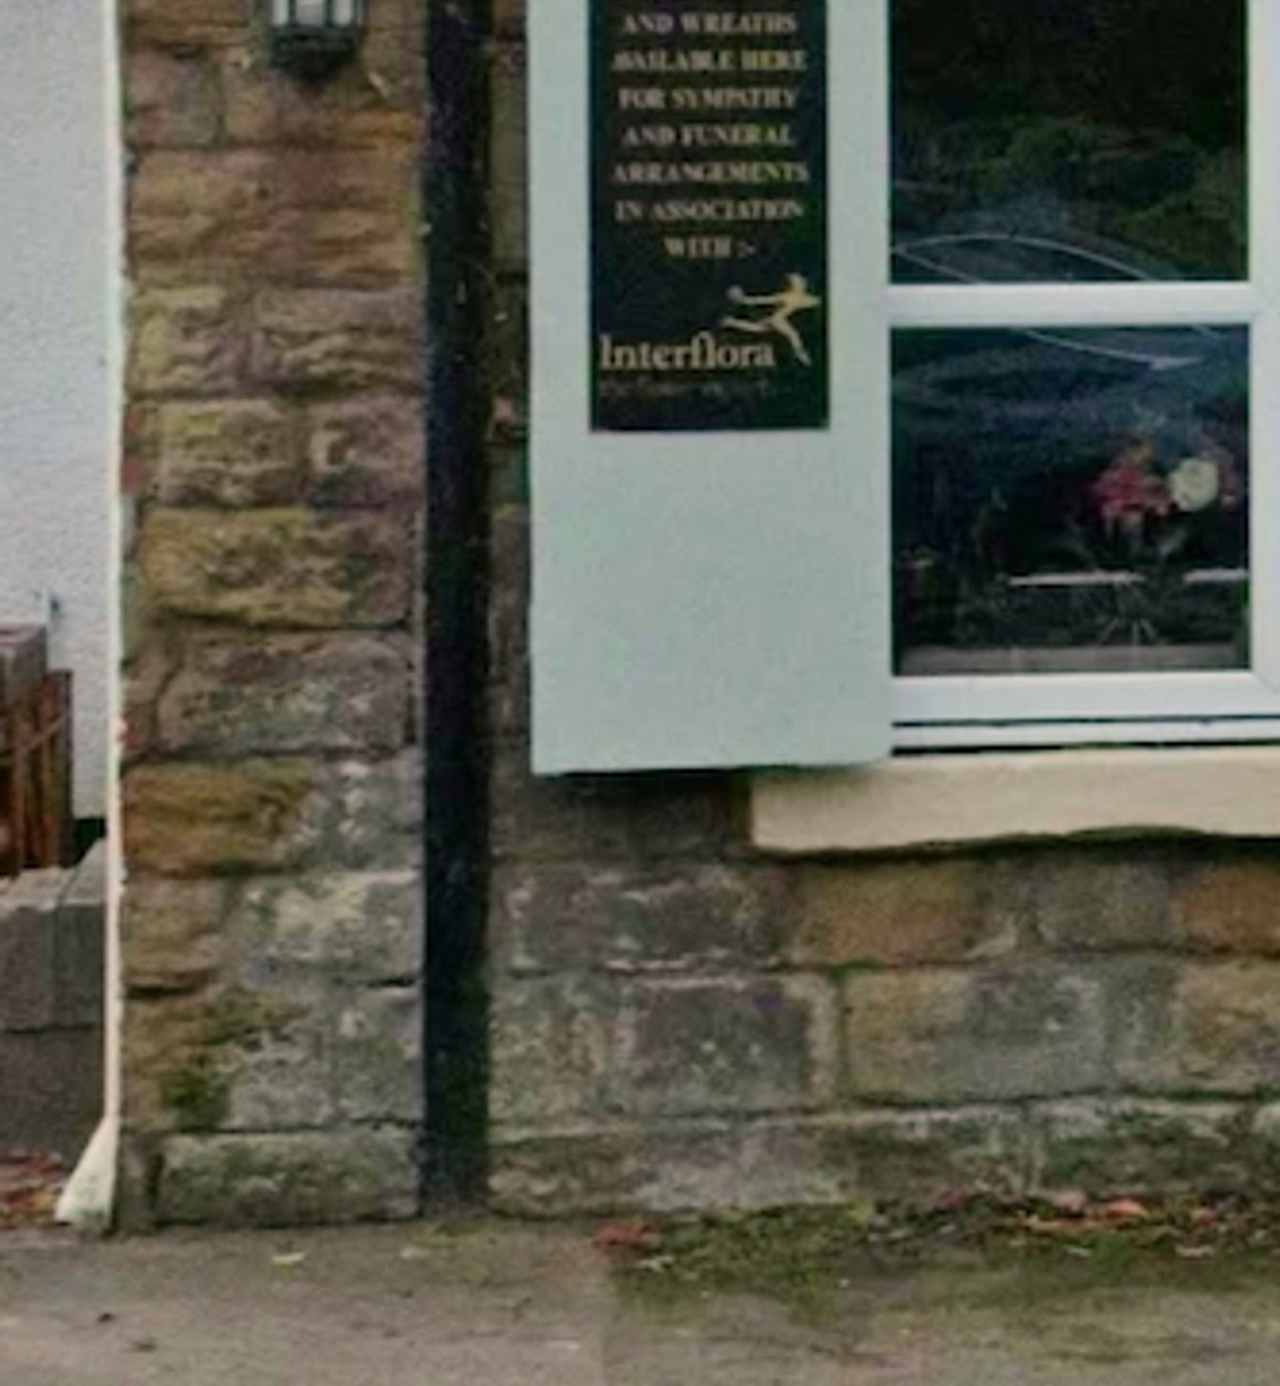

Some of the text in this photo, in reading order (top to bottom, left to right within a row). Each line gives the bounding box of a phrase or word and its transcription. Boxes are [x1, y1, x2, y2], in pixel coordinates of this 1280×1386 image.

[622, 14, 798, 34] AND WREATHS
[610, 50, 808, 71] AVAILABLE HERE
[617, 87, 797, 109] FOR SYMPATHY
[622, 125, 796, 148] AND FUNERAL
[611, 161, 811, 184] ARRANGEMENTS
[614, 200, 805, 222] IN ASSOCIATION
[663, 237, 733, 258] WITH
[598, 329, 777, 370] Interflora
